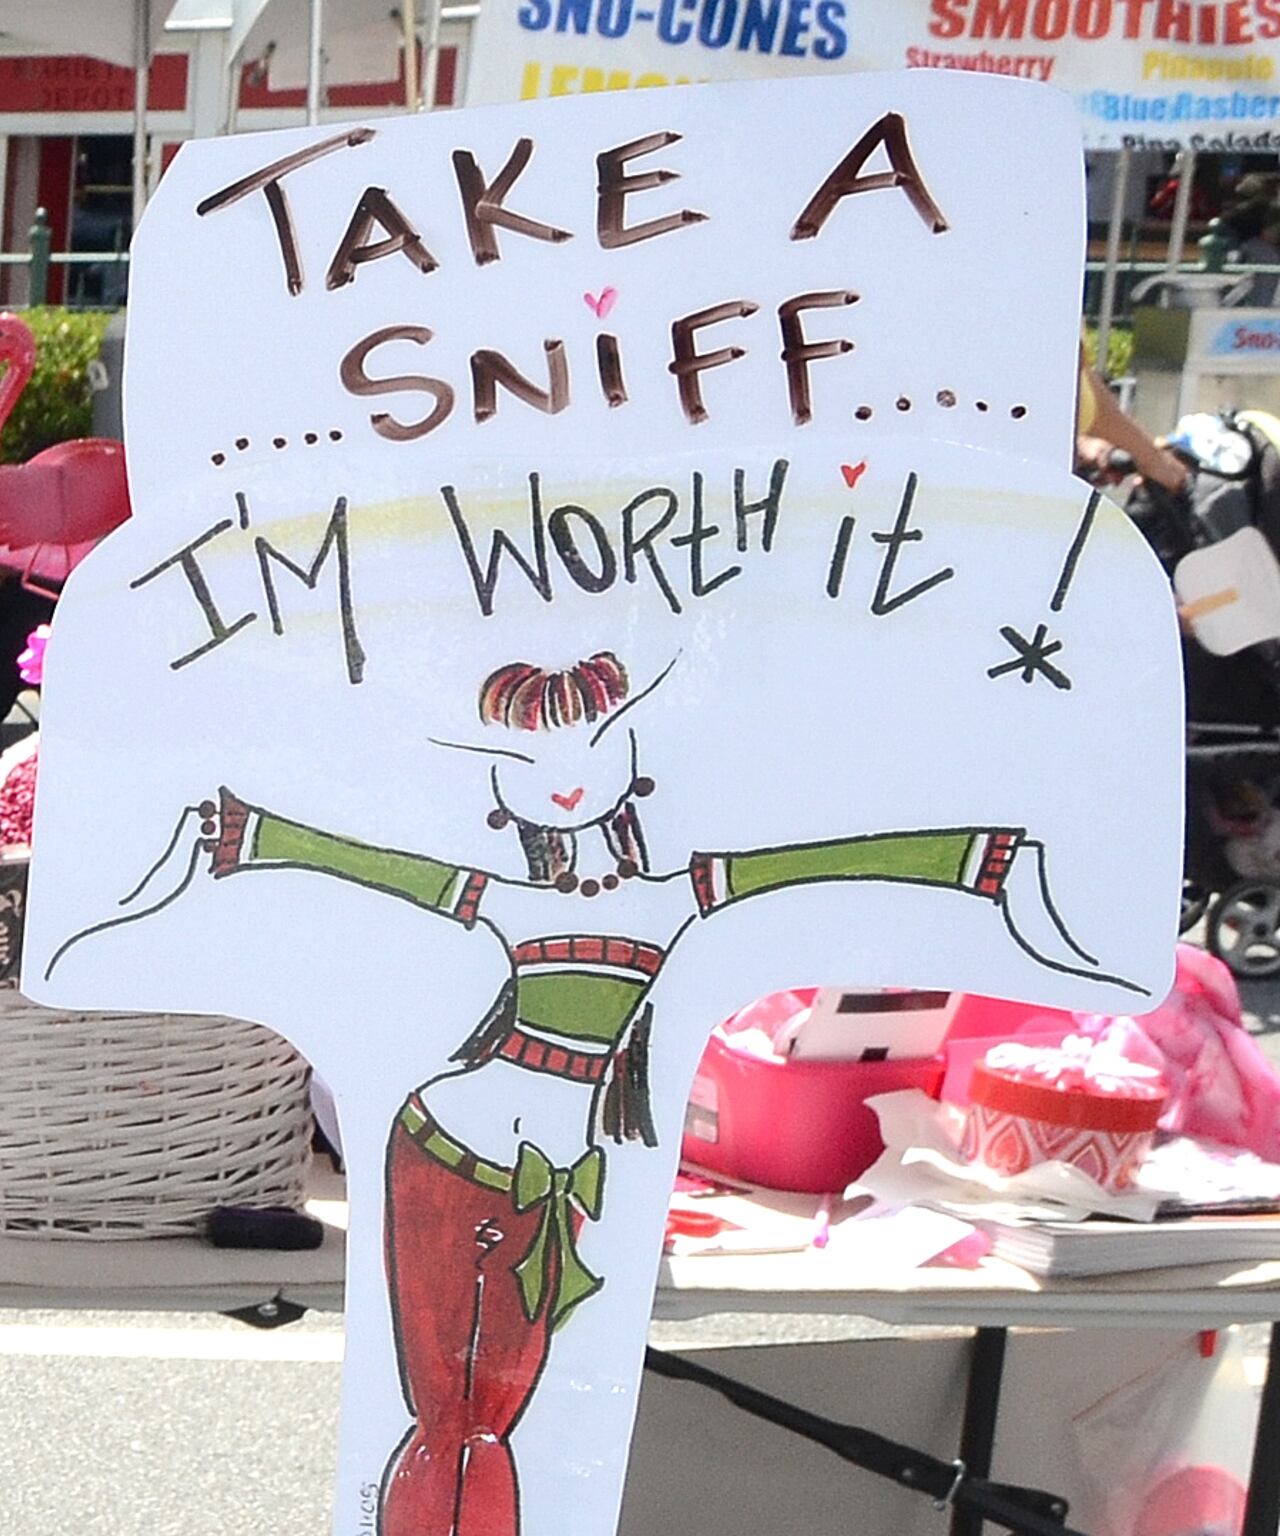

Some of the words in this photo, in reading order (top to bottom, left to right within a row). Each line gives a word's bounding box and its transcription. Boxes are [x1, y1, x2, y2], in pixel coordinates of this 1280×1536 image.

[518, 0, 850, 60] SNO-CONES
[906, 47, 1056, 82] Strawberry
[197, 126, 711, 297] TAKE
[791, 111, 949, 241] A
[132, 492, 364, 684] I'M
